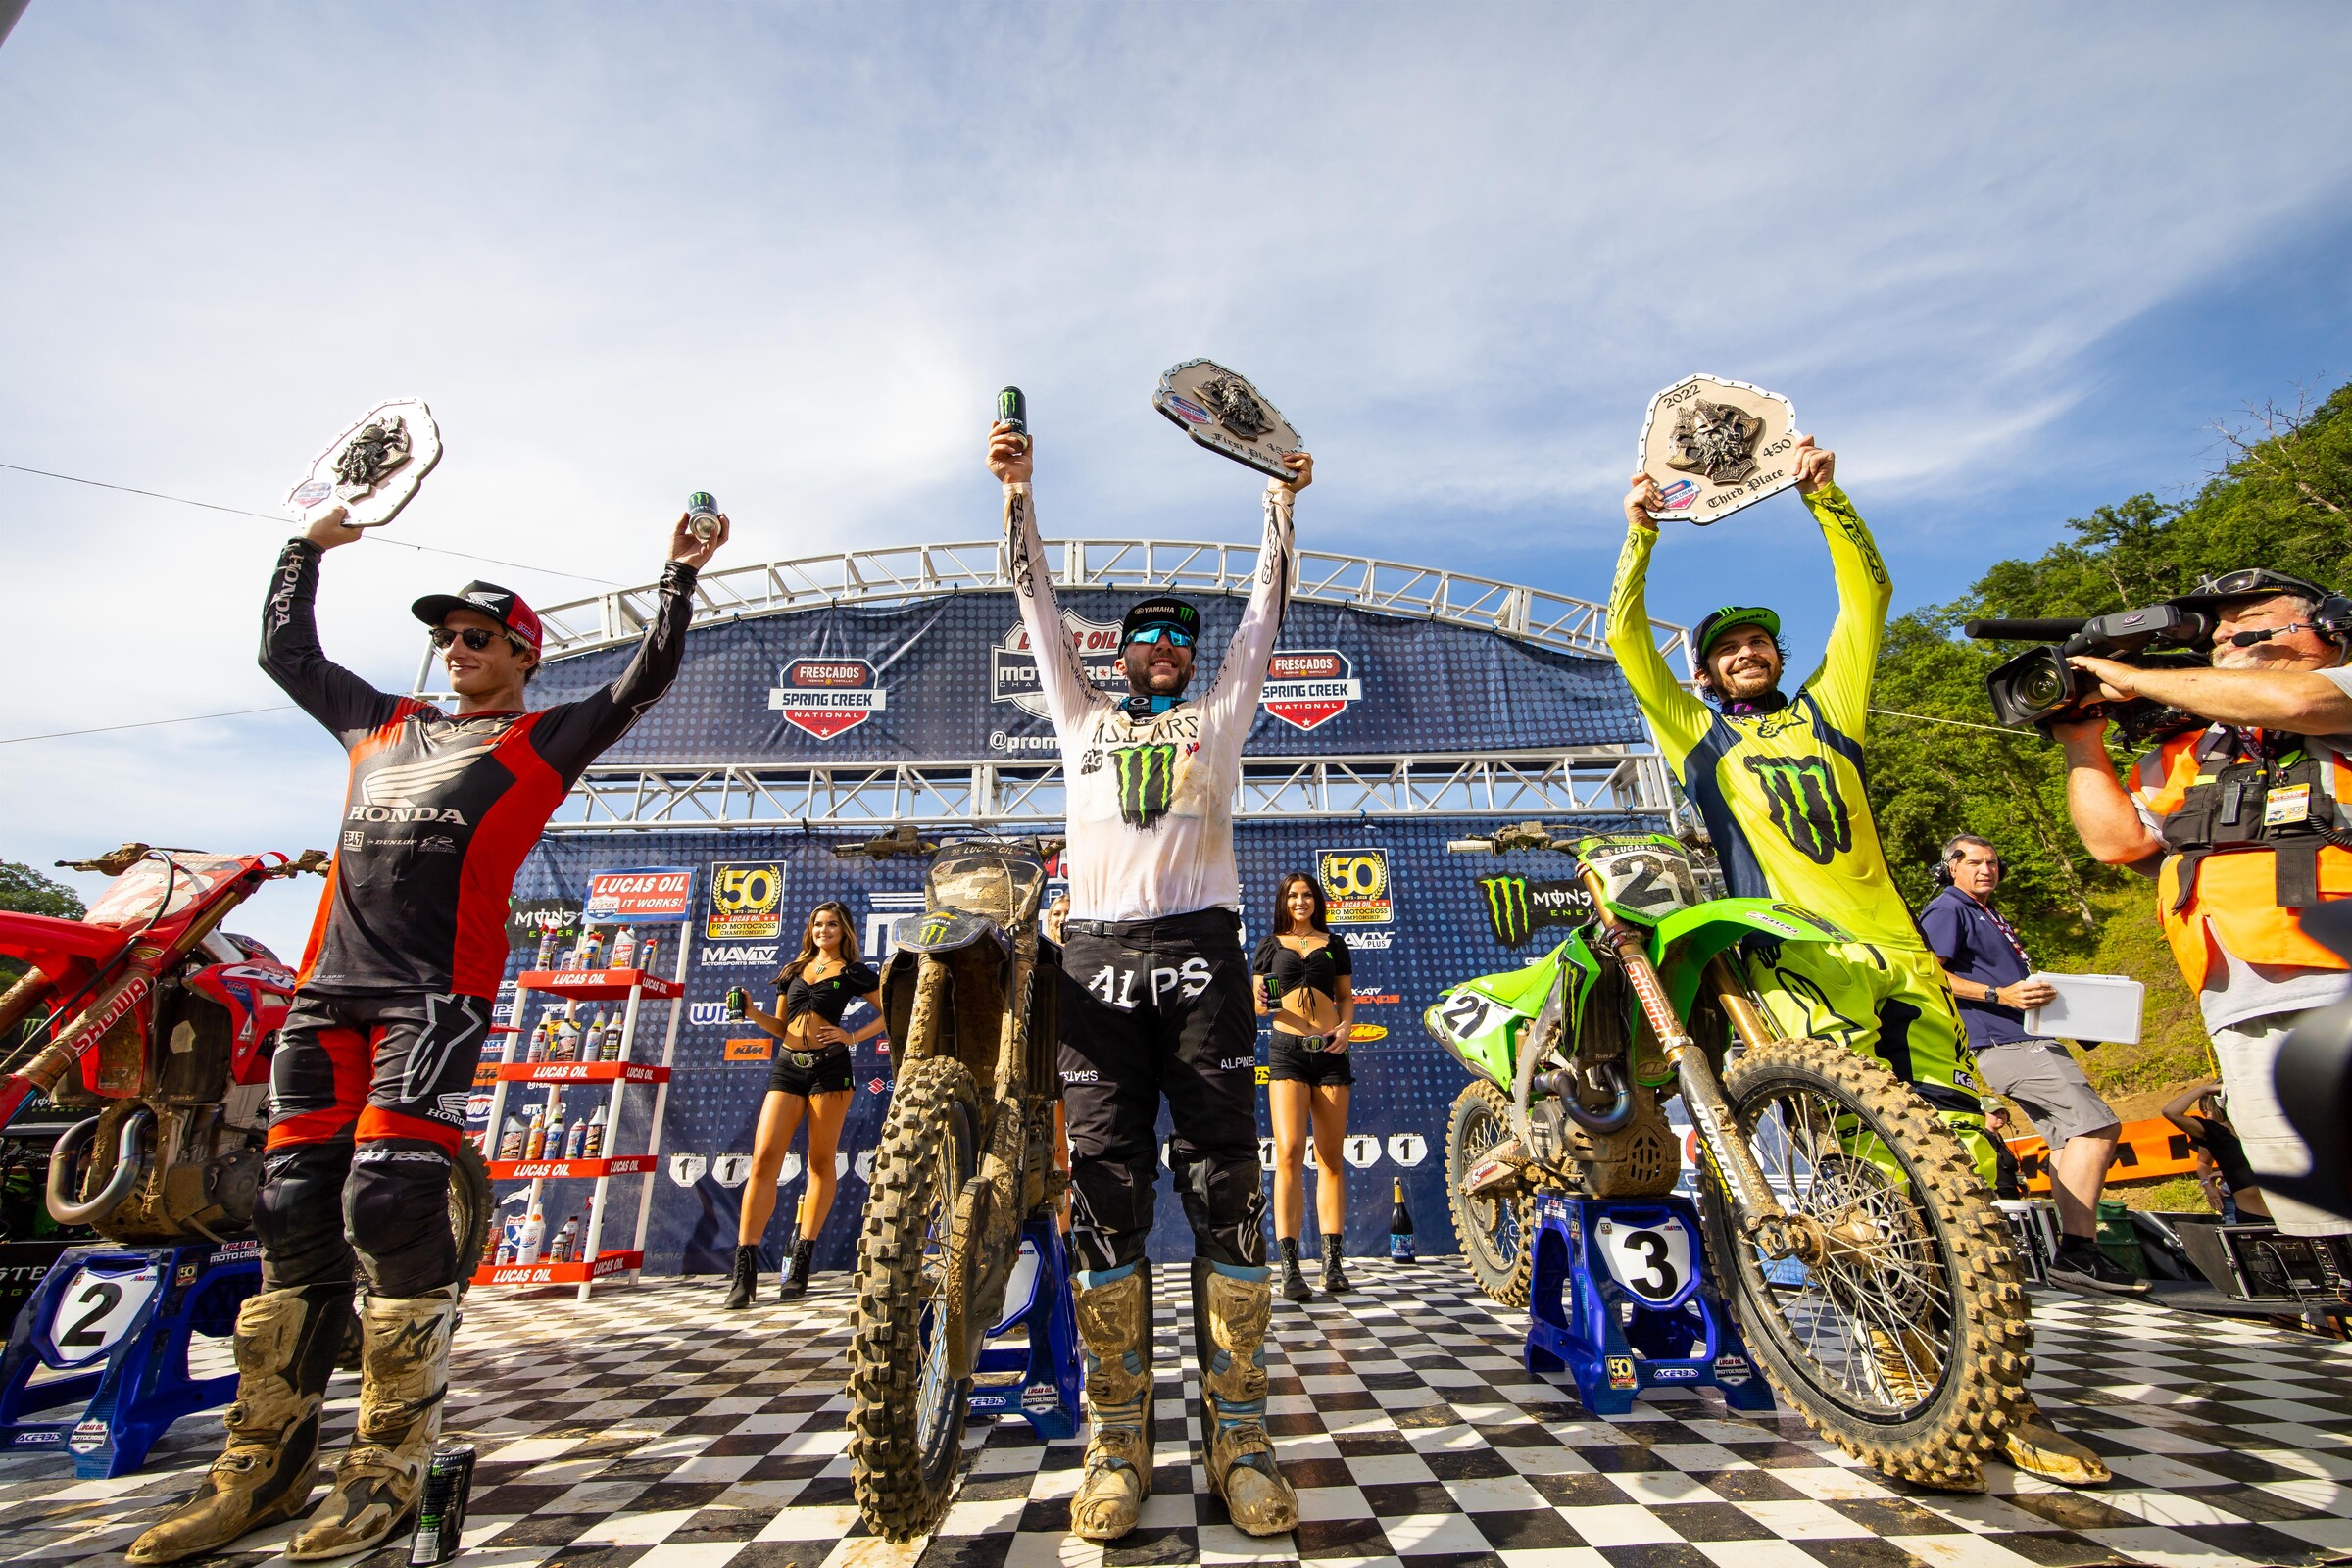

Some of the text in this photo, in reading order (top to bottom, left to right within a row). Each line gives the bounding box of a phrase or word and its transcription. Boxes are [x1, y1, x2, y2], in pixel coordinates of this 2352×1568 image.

[1663, 384, 1701, 409] 2022
[1211, 433, 1279, 467] First Place
[1763, 439, 1792, 458] 450
[1706, 487, 1744, 509] Third
[1747, 468, 1785, 492] Place
[274, 552, 305, 632] HONDA
[466, 599, 500, 612] HONDA
[1087, 631, 1117, 649] OIL
[800, 666, 859, 678] FRESCADOS
[1275, 659, 1333, 670] FRESCADOS
[782, 693, 872, 706] SPRING CREEK
[1262, 684, 1348, 698] SPRING CREEK
[348, 806, 467, 825] HONDA
[1615, 845, 1646, 854] LUCAS
[597, 876, 684, 893] LUCAS OIL
[1329, 858, 1381, 896] 50
[721, 870, 776, 909] 50
[621, 898, 683, 907] IT WORKS!
[1617, 904, 1653, 920] Kawasaki
[552, 973, 606, 984] LUCAS OIL
[642, 977, 667, 994] LUCAS OIL
[1088, 957, 1214, 1008] ALPS
[1625, 961, 1673, 1032] SHOWA
[69, 977, 148, 1057] SHOWA
[1442, 995, 1491, 1039] 21
[733, 1044, 764, 1054] KTM
[533, 1066, 588, 1078] LUCAS OIL
[626, 1066, 654, 1080] LUCAS OIL
[1691, 1102, 1748, 1204] DUNLOP
[513, 1164, 570, 1176] LUCAS OIL
[610, 1160, 639, 1173] LUCAS OIL
[179, 1265, 196, 1277] 50
[594, 1257, 624, 1275] LUCAS OIL
[1624, 1230, 1678, 1298] 3
[493, 1268, 551, 1283] LUCAS OIL
[59, 1282, 122, 1347] 2
[1611, 1358, 1631, 1377] 50
[968, 1397, 1006, 1406] CERBIS
[15, 1433, 62, 1443] ACERBIS
